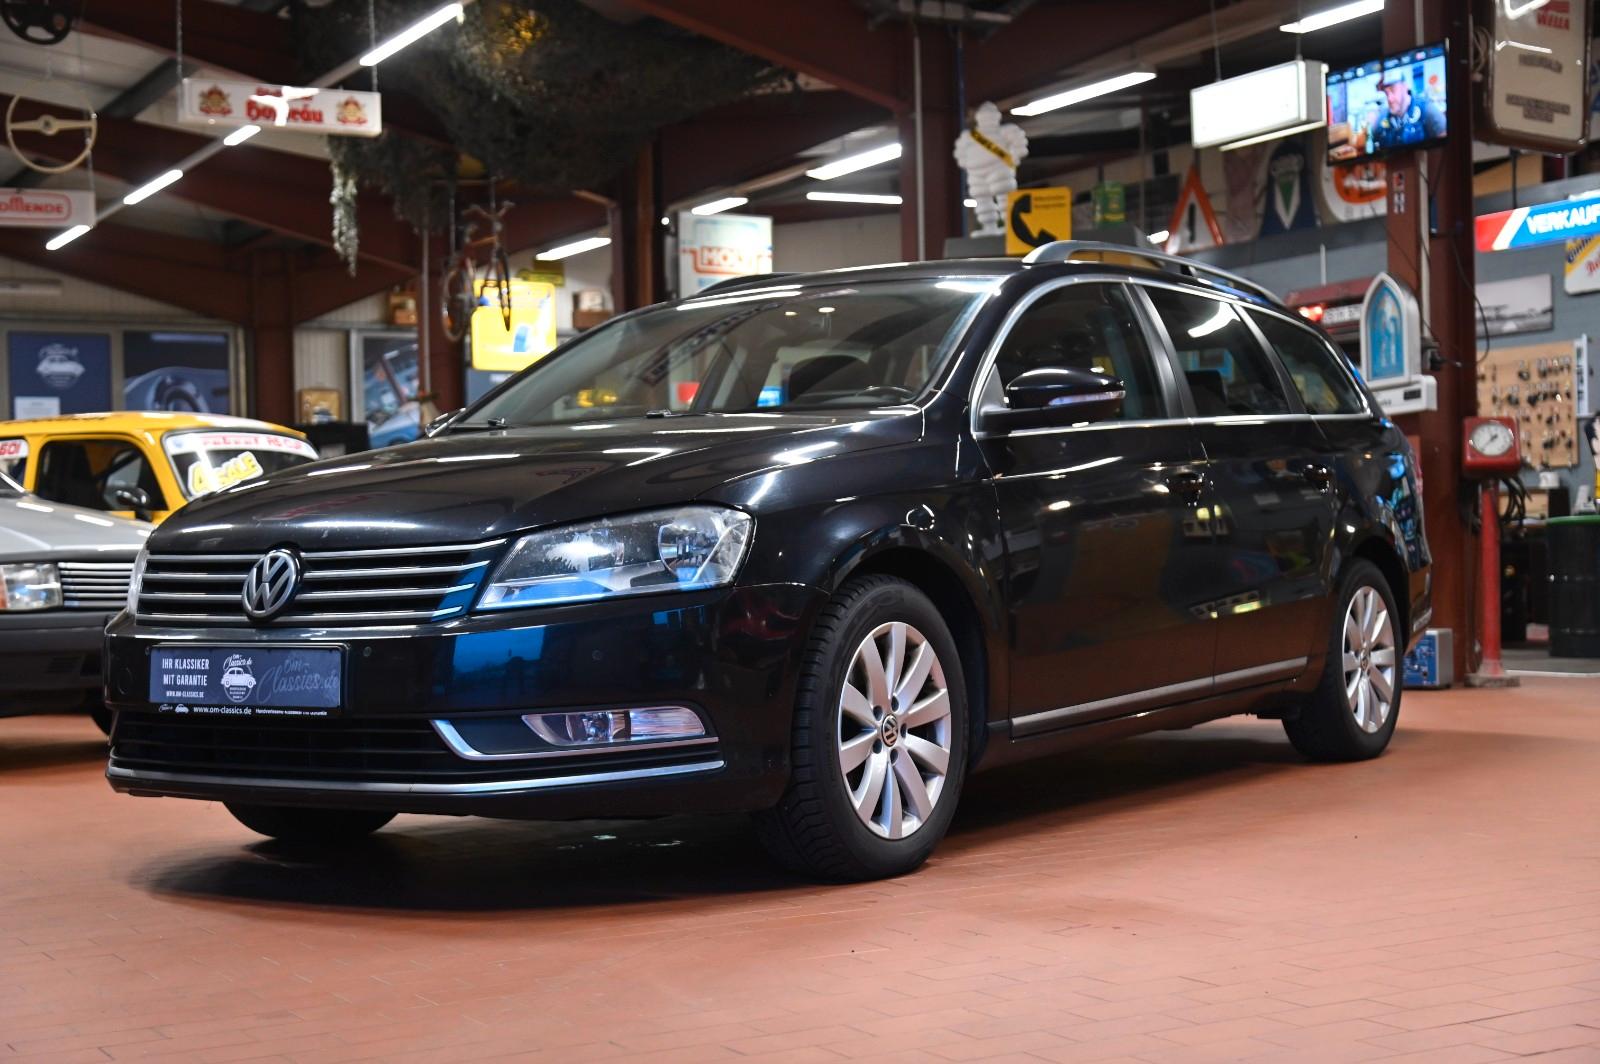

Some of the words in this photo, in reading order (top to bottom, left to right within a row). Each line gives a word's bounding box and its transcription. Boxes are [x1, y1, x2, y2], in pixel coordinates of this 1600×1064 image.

[162, 658, 173, 670] IHR
[174, 658, 210, 670] KLASSIKER
[163, 674, 175, 686] MIT
[176, 674, 208, 687] GARANTIE
[193, 705, 252, 715] www.om-classics.de
